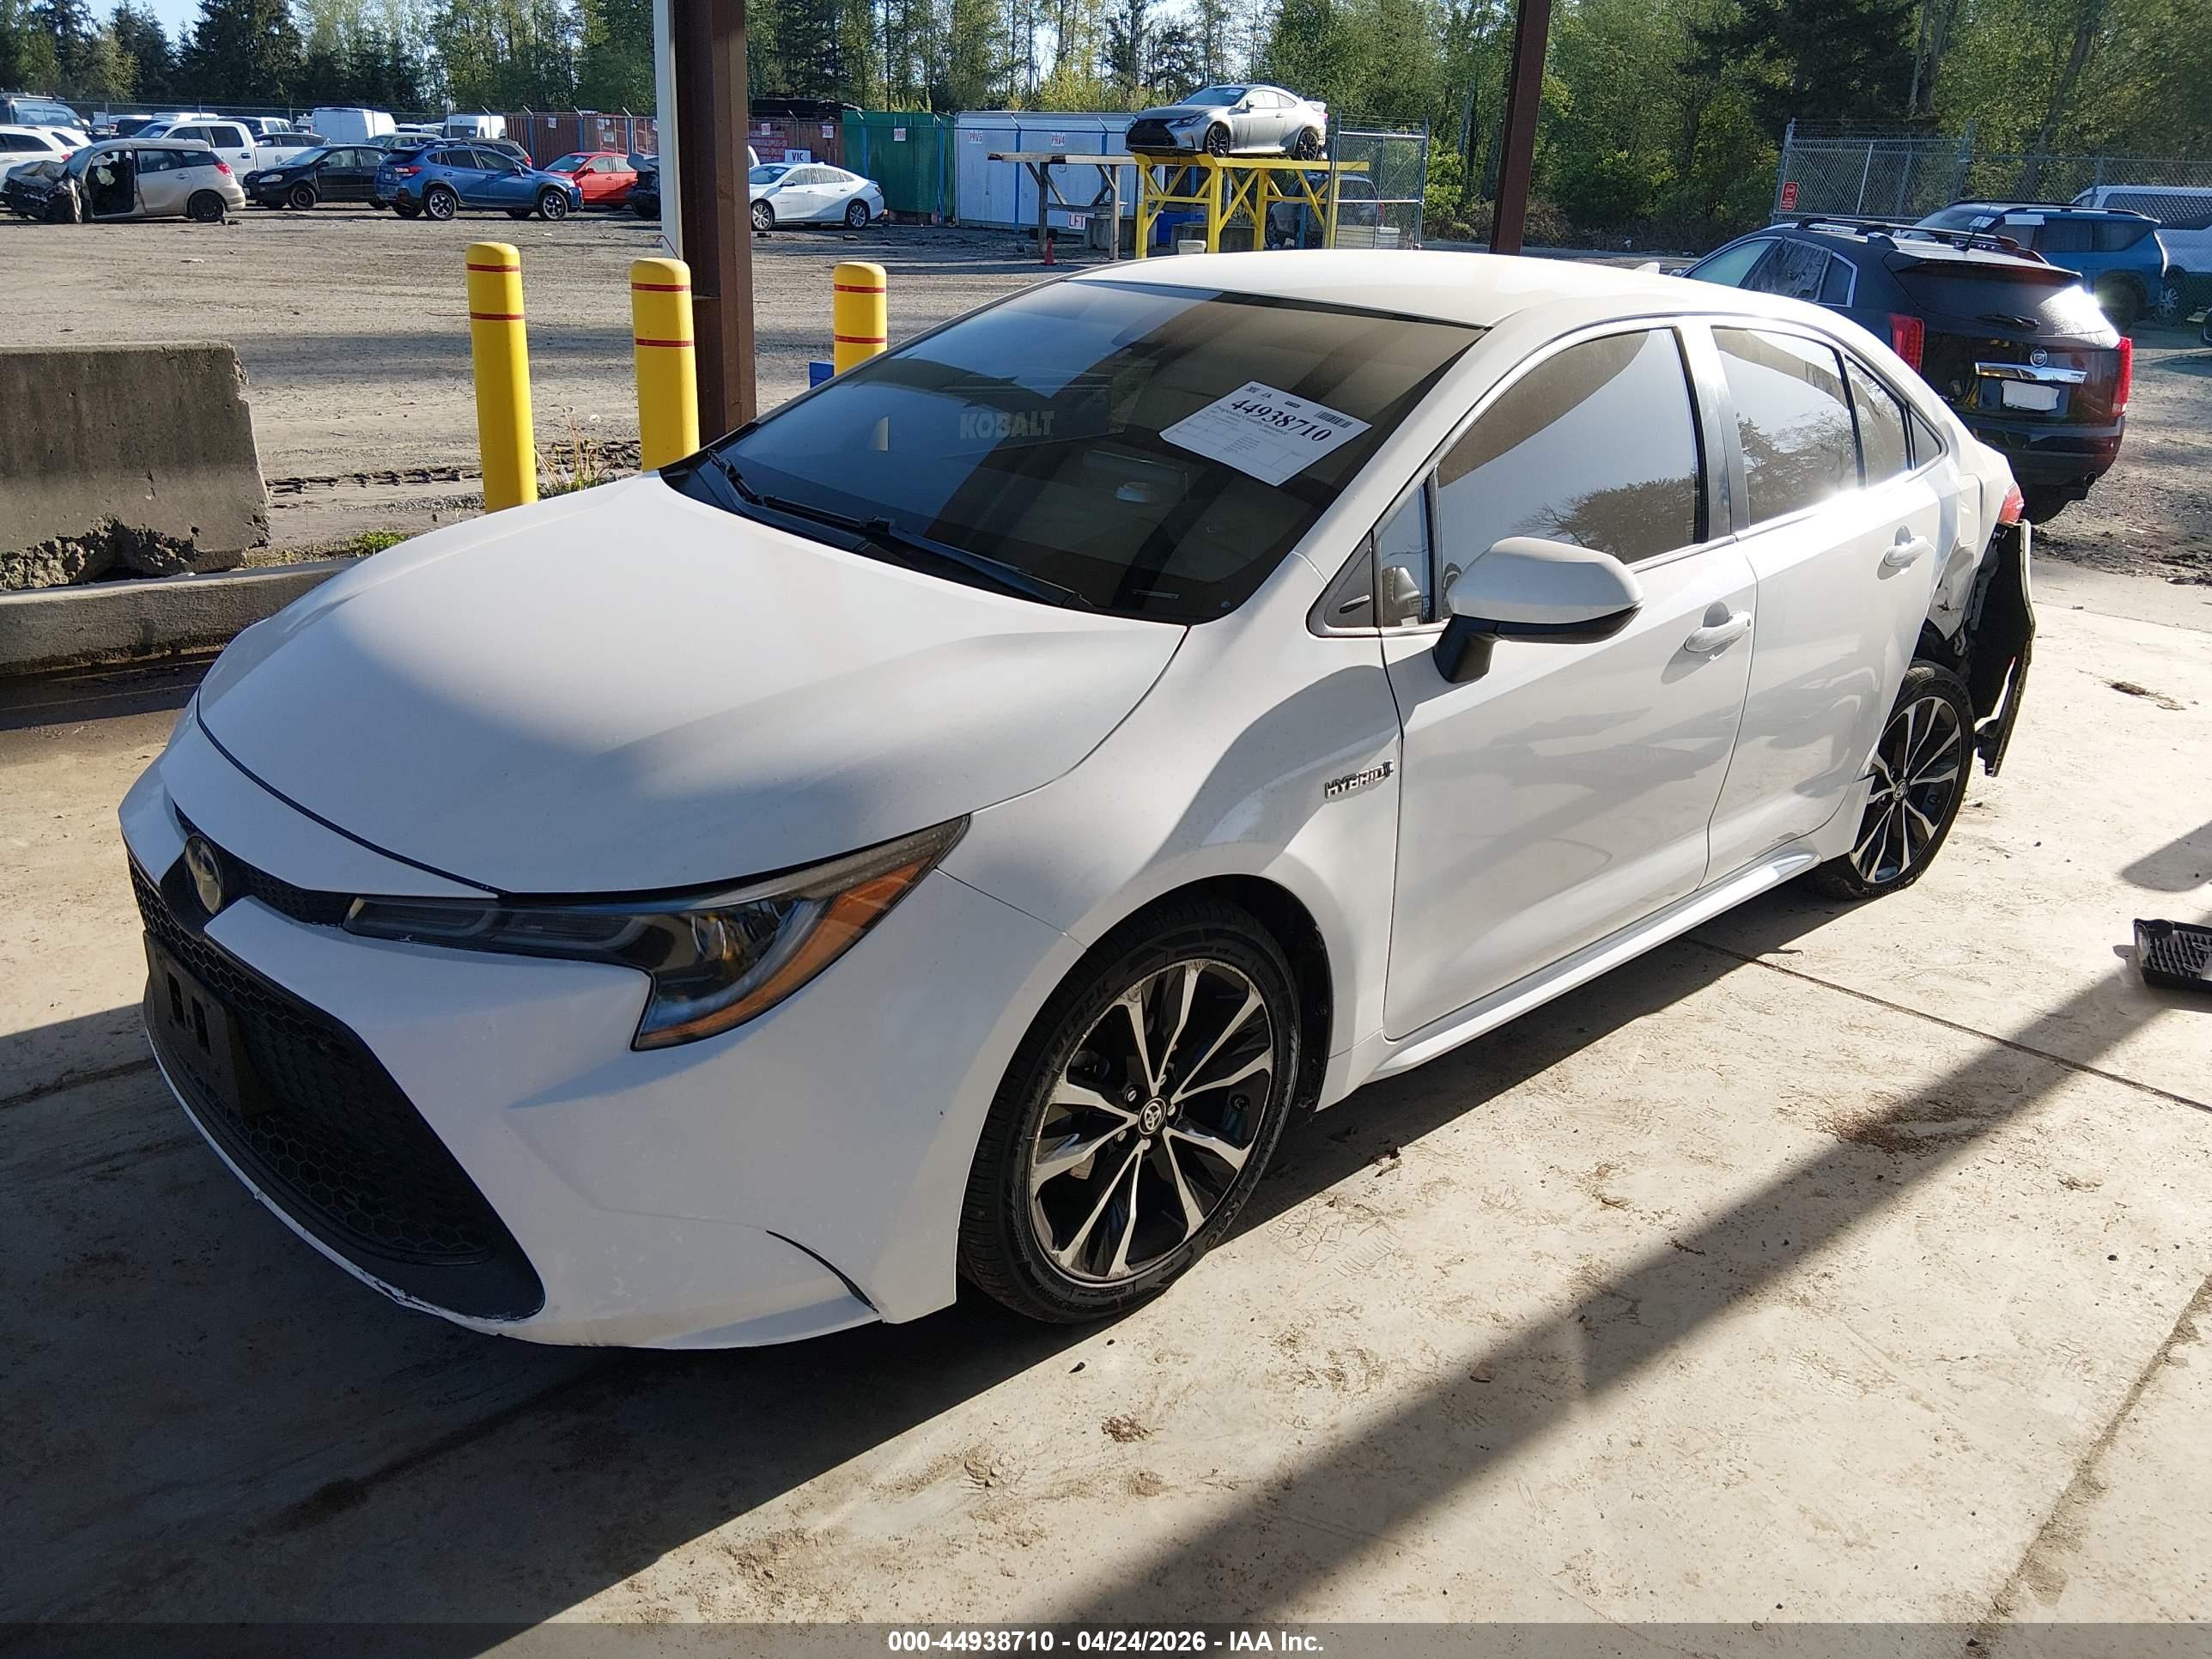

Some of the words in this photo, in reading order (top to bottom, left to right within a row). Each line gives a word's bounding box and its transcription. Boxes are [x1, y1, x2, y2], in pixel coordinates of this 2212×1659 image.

[1051, 134, 1066, 145] PRV4
[791, 152, 804, 161] VIC
[1068, 215, 1085, 228] LFT
[960, 411, 1055, 440] KOBALT
[1231, 399, 1333, 441] 44938710
[1325, 764, 1385, 799] HYBRID
